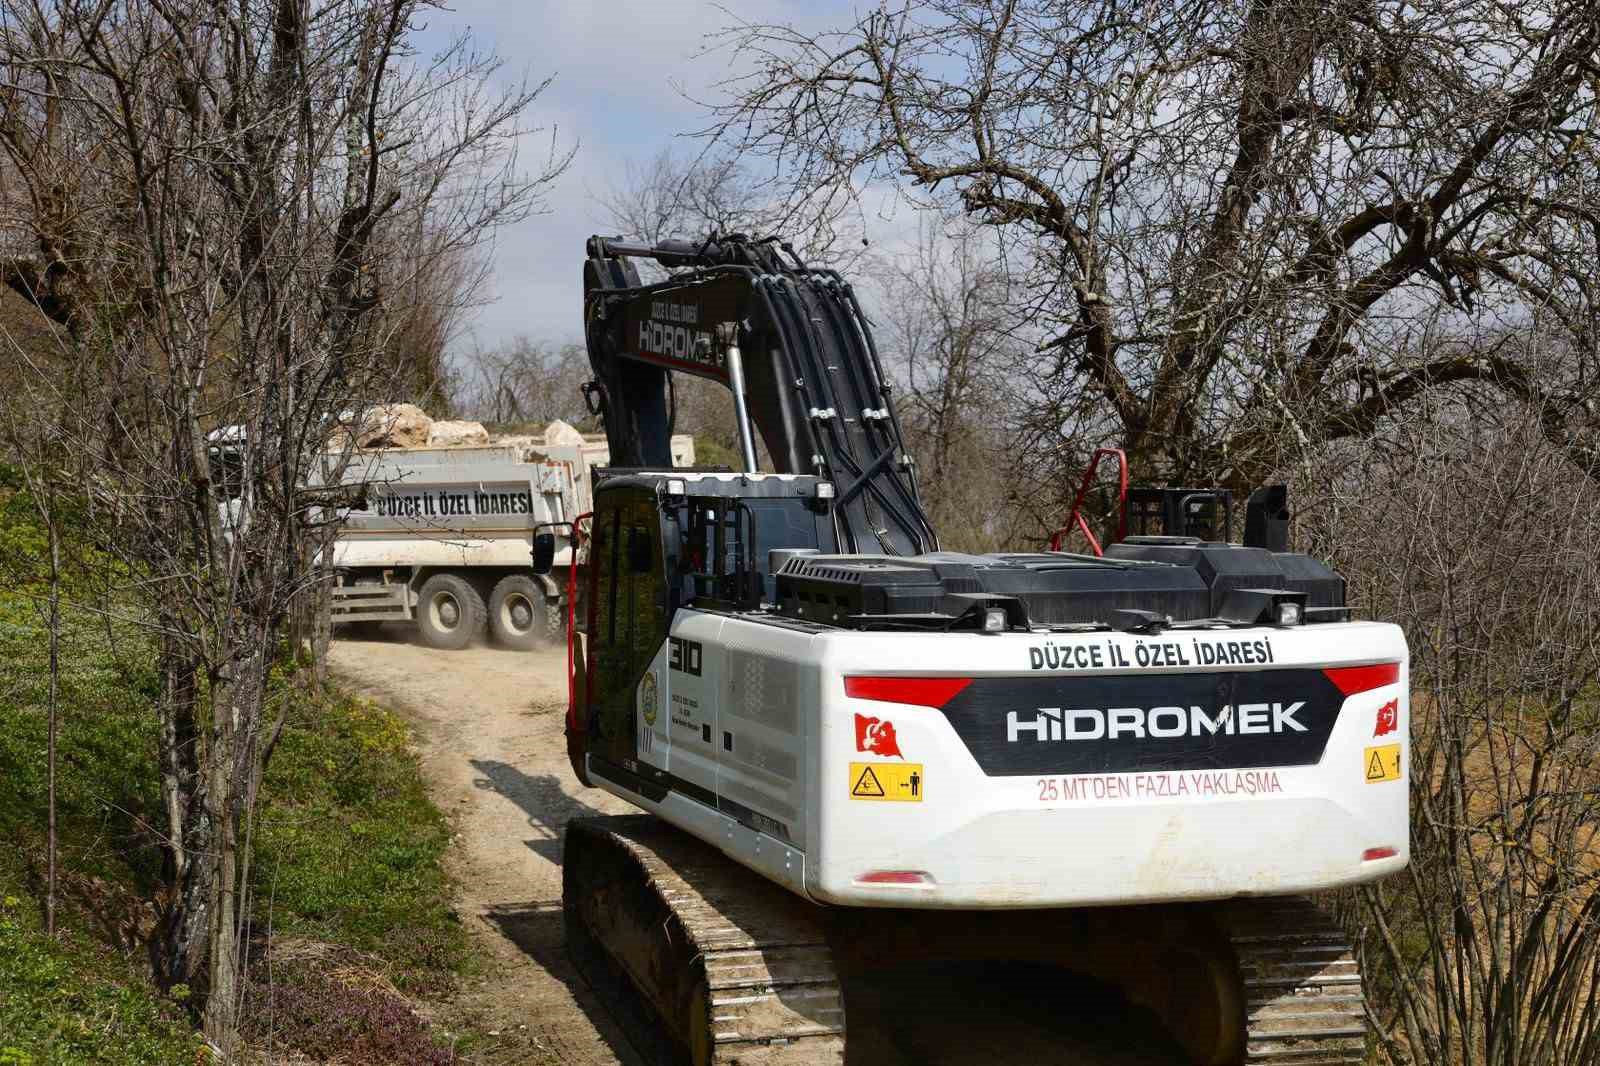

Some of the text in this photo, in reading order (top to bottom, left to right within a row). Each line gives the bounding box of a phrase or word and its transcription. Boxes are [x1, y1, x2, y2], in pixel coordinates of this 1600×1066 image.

[423, 491, 436, 515] İL
[439, 491, 471, 515] ÖZEL
[474, 489, 534, 514] İDARESİ
[669, 636, 702, 677] 310
[1030, 636, 1274, 670] DÜZCE İL ÖZEL İDARESİ
[1038, 771, 1282, 801] 25 MT'DEN FAZLA YAKLAŞMA
